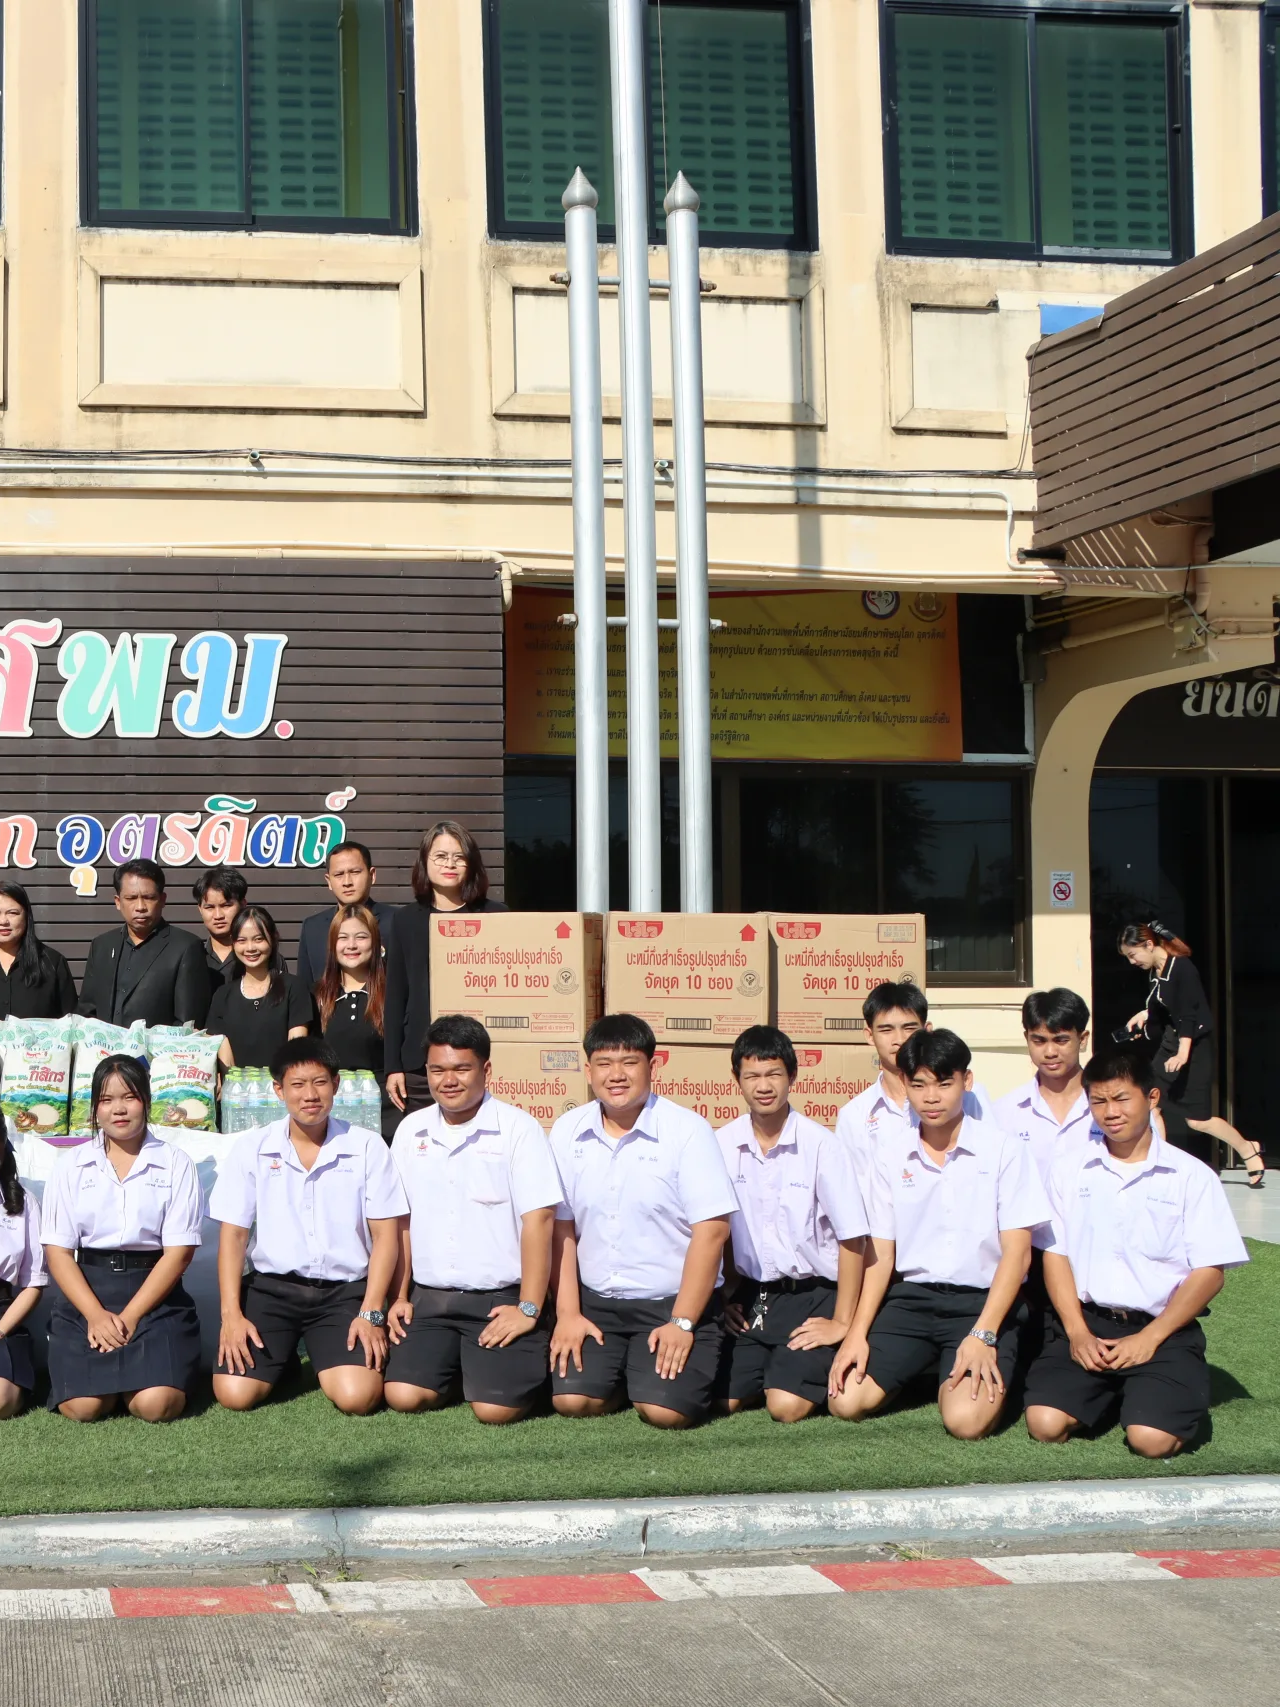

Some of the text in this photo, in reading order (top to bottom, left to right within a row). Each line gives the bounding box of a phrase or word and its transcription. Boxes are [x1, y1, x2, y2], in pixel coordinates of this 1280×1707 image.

[56, 786, 357, 897] อุตรดิตถ์
[446, 945, 563, 970] บะหมี่กึ่งสำเร็จรูปปรุงสำเร็จ
[626, 946, 748, 972] บะหมี่กึ่งสำเร็จรูปปรุงสำเร็จ
[784, 947, 904, 973] บะหมี่กึ่งสำเร็จรูปปรุงสำเร็จ
[464, 970, 550, 993] จัดชุด 10 ซอง
[644, 972, 734, 995] จัดชุด 10 ซอง
[803, 973, 837, 995] จัดชุด
[843, 975, 859, 991] 10
[529, 1104, 554, 1119] ซอง
[714, 1105, 739, 1119] ซอง
[803, 1101, 838, 1122] จัดชุด
